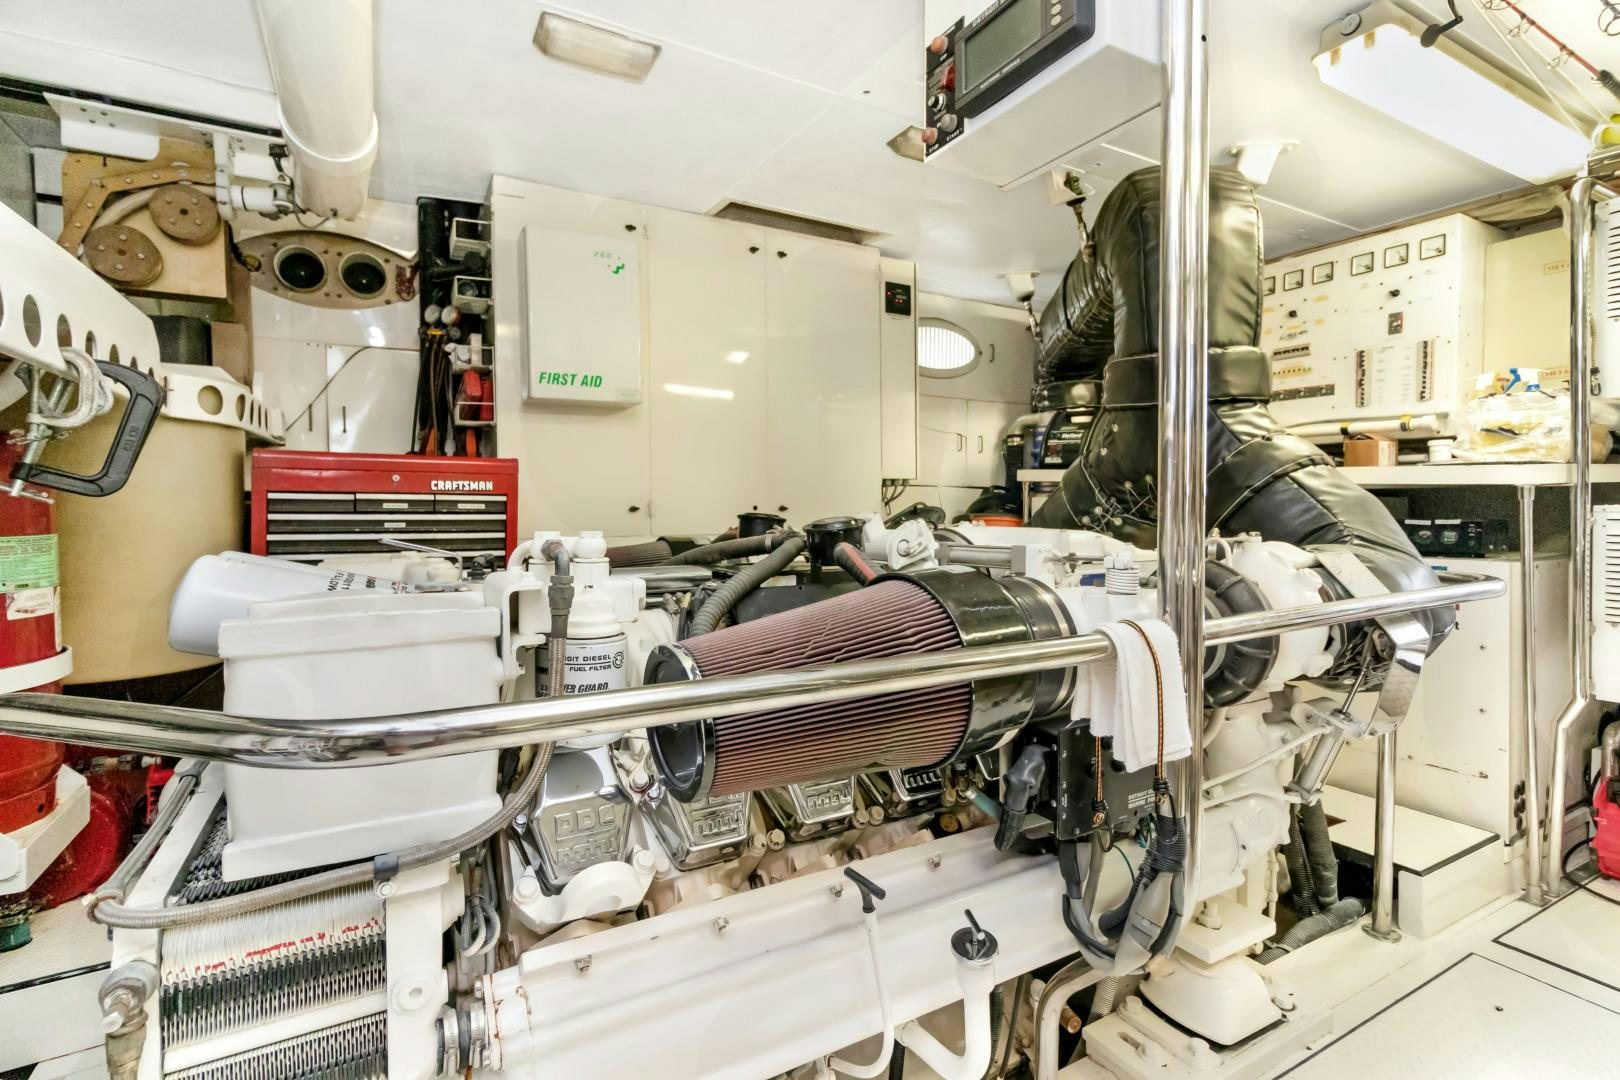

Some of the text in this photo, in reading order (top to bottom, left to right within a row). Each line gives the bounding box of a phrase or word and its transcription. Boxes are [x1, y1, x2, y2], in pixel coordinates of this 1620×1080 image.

[538, 371, 603, 388] FIRST AID
[431, 480, 493, 491] CRAFTSMAN
[583, 654, 612, 662] DIESEL
[589, 664, 612, 672] FILTER
[577, 682, 609, 693] GUARD
